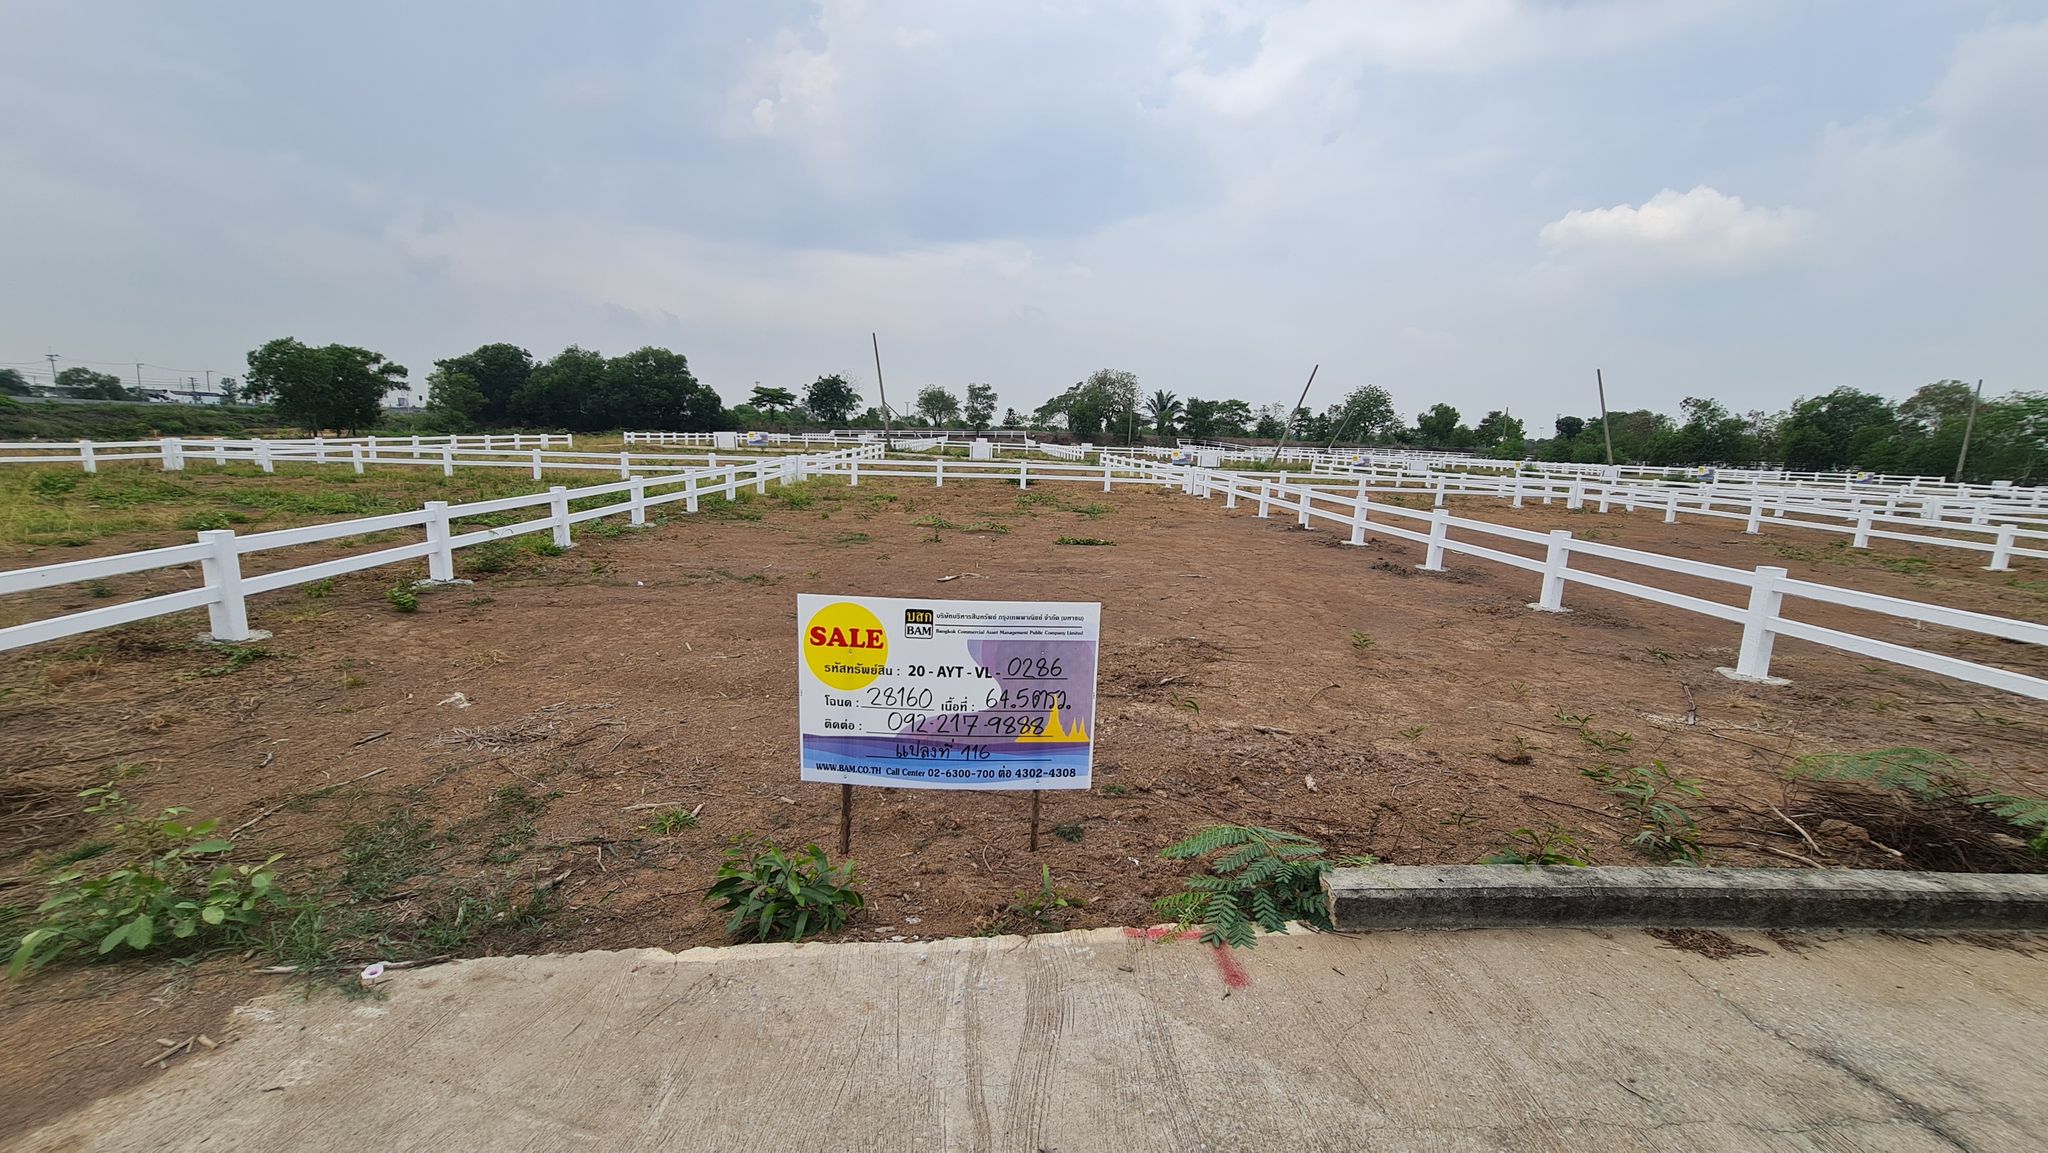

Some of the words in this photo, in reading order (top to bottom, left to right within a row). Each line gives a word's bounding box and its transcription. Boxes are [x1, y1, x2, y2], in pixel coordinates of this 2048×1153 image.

[906, 611, 932, 622] บสก
[809, 626, 884, 649] SALE
[906, 626, 932, 636] BAM
[824, 662, 893, 676] รหัสทรัพย์สิน
[1007, 657, 1062, 679] 0286
[824, 695, 852, 707] โฉนด
[867, 687, 933, 709] 28160
[824, 719, 855, 731] ติดต่อ
[961, 744, 990, 760] 116
[816, 762, 882, 775] WWW.BAM.CO.TH
[886, 767, 901, 776] Call
[902, 768, 926, 777] Center
[928, 768, 995, 779] 02-6300-700
[998, 765, 1012, 778] ต่อ
[1015, 768, 1076, 778] 4302-4308
